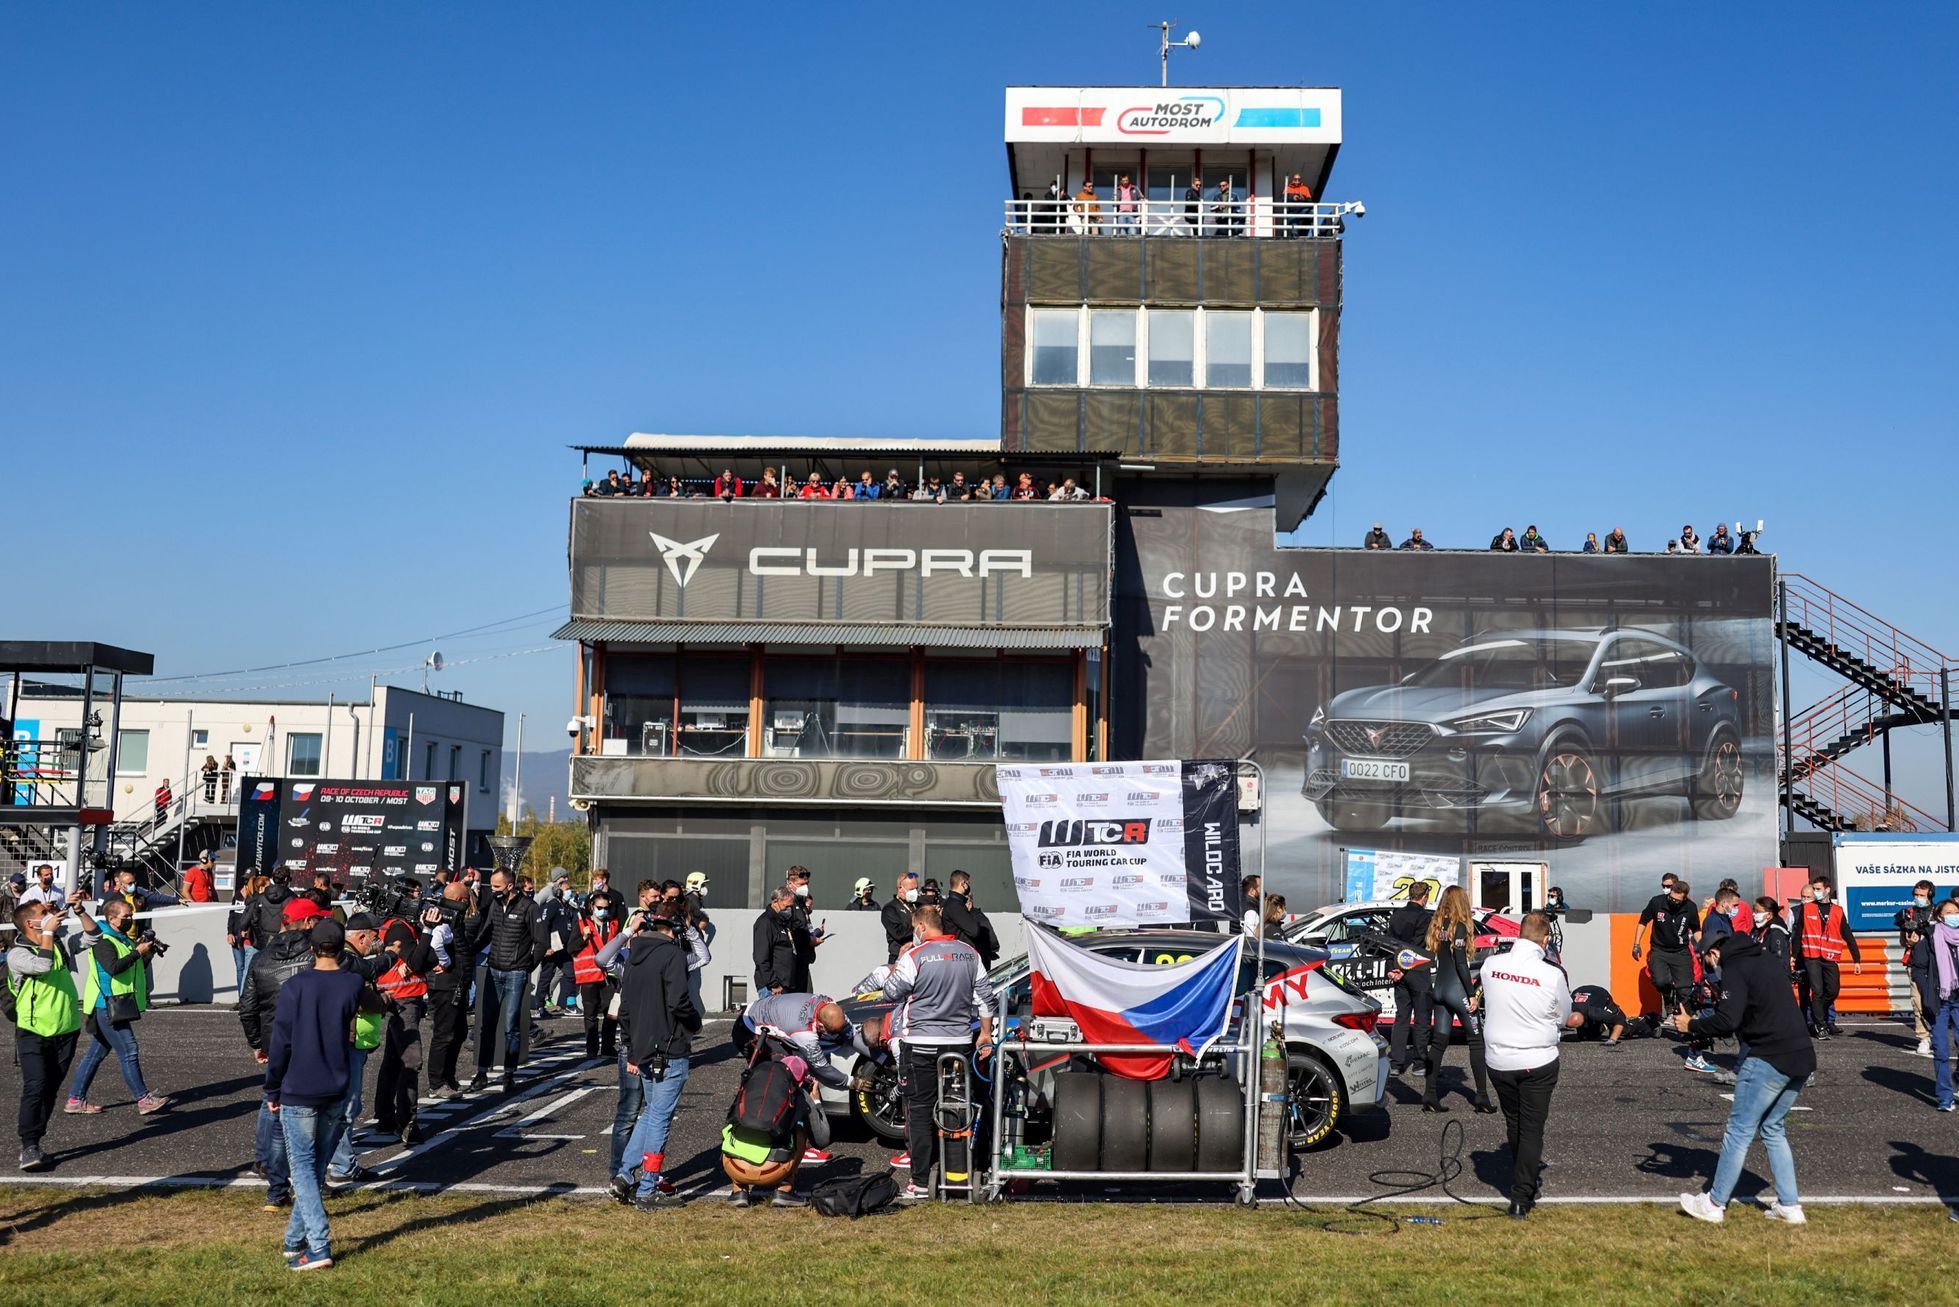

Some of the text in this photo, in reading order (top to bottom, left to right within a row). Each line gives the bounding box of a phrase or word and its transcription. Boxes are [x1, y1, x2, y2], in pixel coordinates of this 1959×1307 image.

[1155, 103, 1204, 115] MOST
[1129, 117, 1212, 128] AUTODROM
[749, 547, 1032, 578] CUPRA
[1162, 571, 1308, 598] CUPRA
[1162, 605, 1433, 634] FORMENTOR
[386, 739, 394, 763] B
[1350, 762, 1379, 777] 0022
[320, 787, 339, 795] RACE
[350, 788, 374, 796] CZECH
[374, 789, 409, 797] REPUBLIC
[344, 796, 379, 804] OCTOBER
[386, 797, 409, 805] MOST
[1038, 818, 1152, 848] WTCR
[447, 827, 456, 871] MOST
[1066, 849, 1117, 858] FIA WORLD
[1066, 857, 1147, 868] TOURING CAR CUP
[1856, 863, 1881, 874] VAŠE
[1883, 863, 1916, 874] SÁZKA
[1919, 866, 1932, 874] NA
[1490, 970, 1541, 987] HONDA
[1307, 1090, 1339, 1144] GOODYEAR
